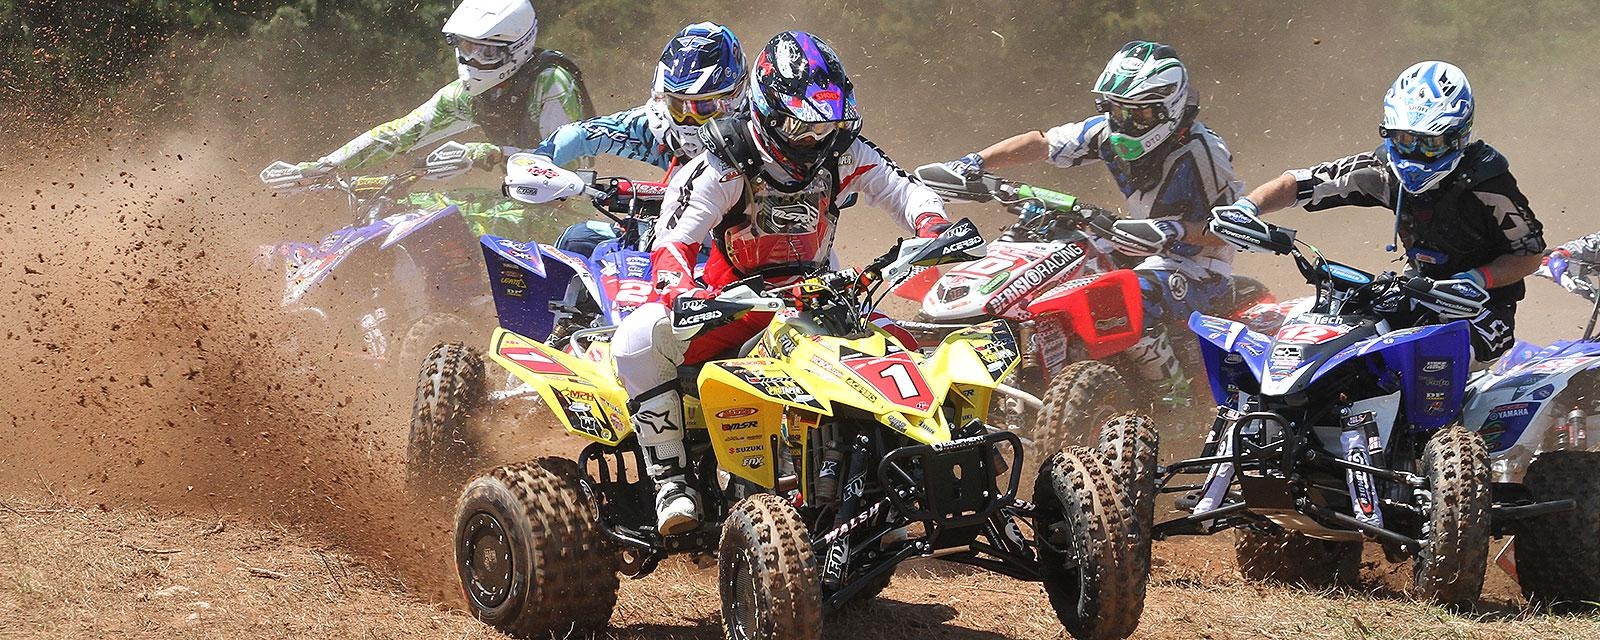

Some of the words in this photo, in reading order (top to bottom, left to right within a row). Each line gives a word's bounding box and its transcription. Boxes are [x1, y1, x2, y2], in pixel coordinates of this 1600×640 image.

[838, 155, 853, 166] APER
[947, 223, 972, 238] FOX
[942, 235, 982, 255] ACERBIS
[1039, 243, 1083, 277] RACING
[615, 283, 652, 302] 2
[681, 300, 707, 311] FOX
[679, 310, 723, 325] ACERBIS
[879, 363, 921, 399] 1
[1499, 408, 1529, 419] YAMAHA
[735, 445, 764, 453] SUZUKI
[741, 455, 765, 469] FOX
